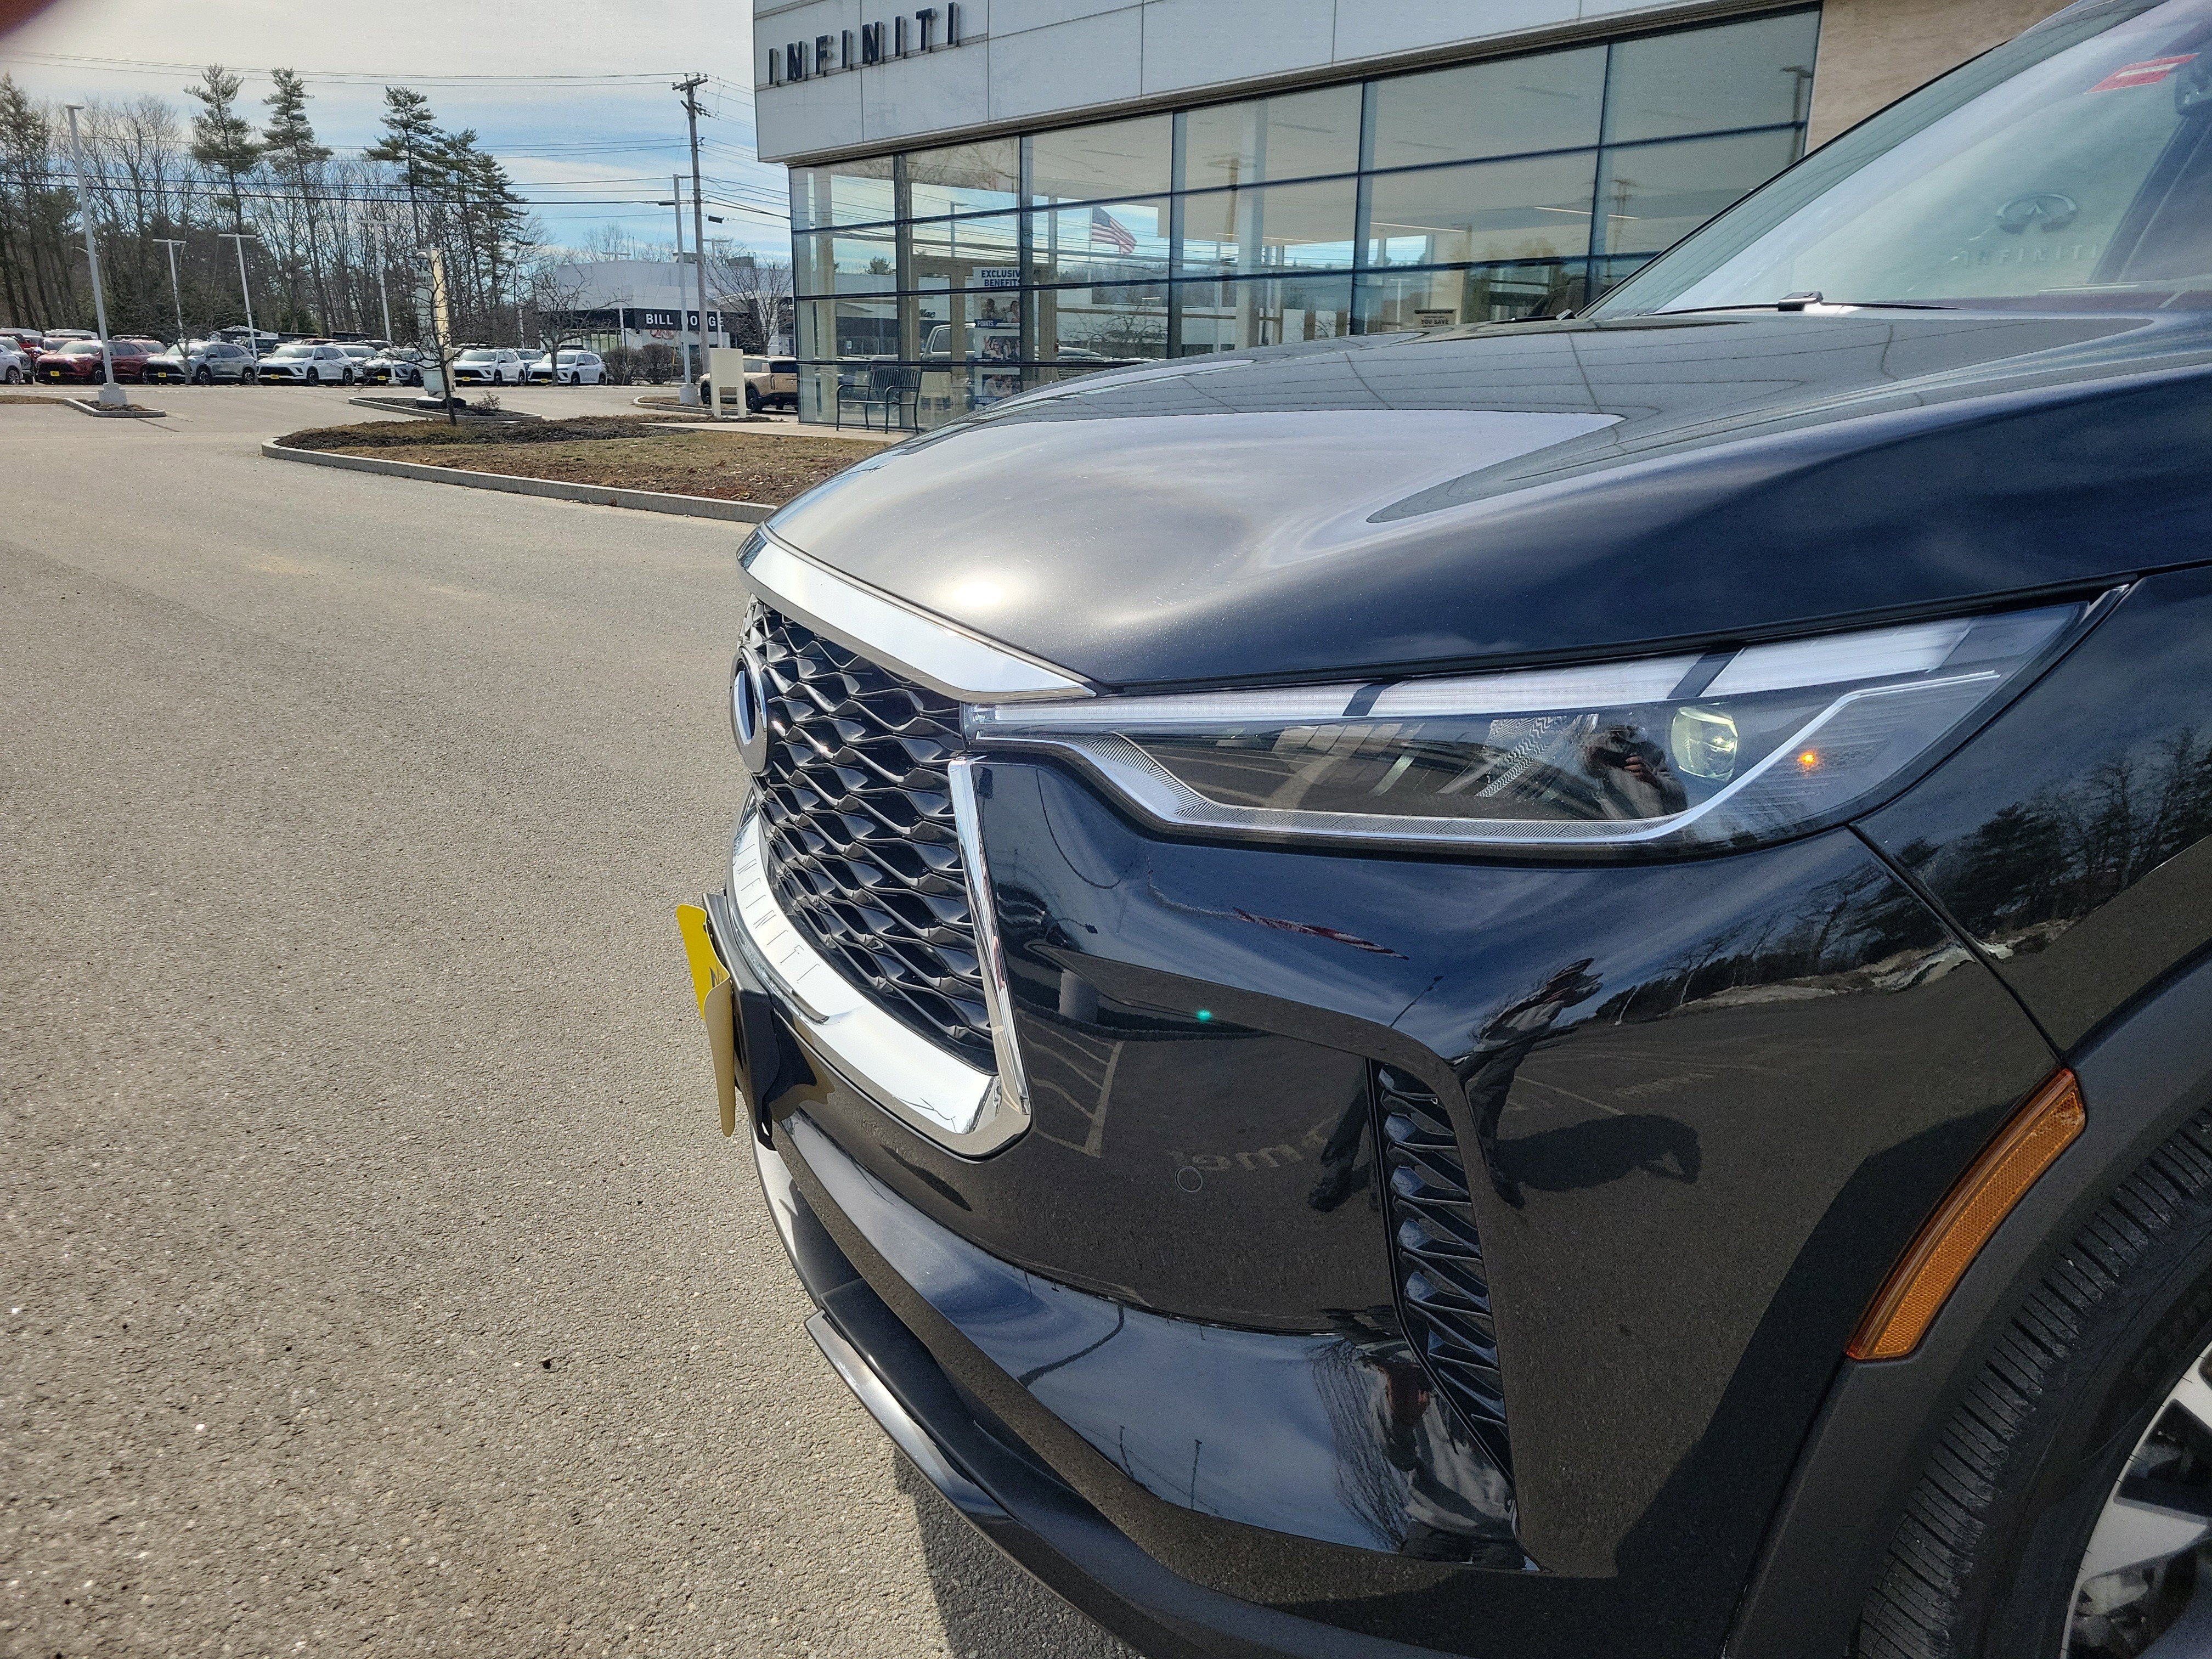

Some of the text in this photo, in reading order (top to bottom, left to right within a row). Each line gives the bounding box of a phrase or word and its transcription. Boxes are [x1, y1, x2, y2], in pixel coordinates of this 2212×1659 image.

[769, 2, 959, 86] INFINITI
[981, 269, 1020, 278] EXCLUSIV
[645, 314, 724, 327] BILL OGE
